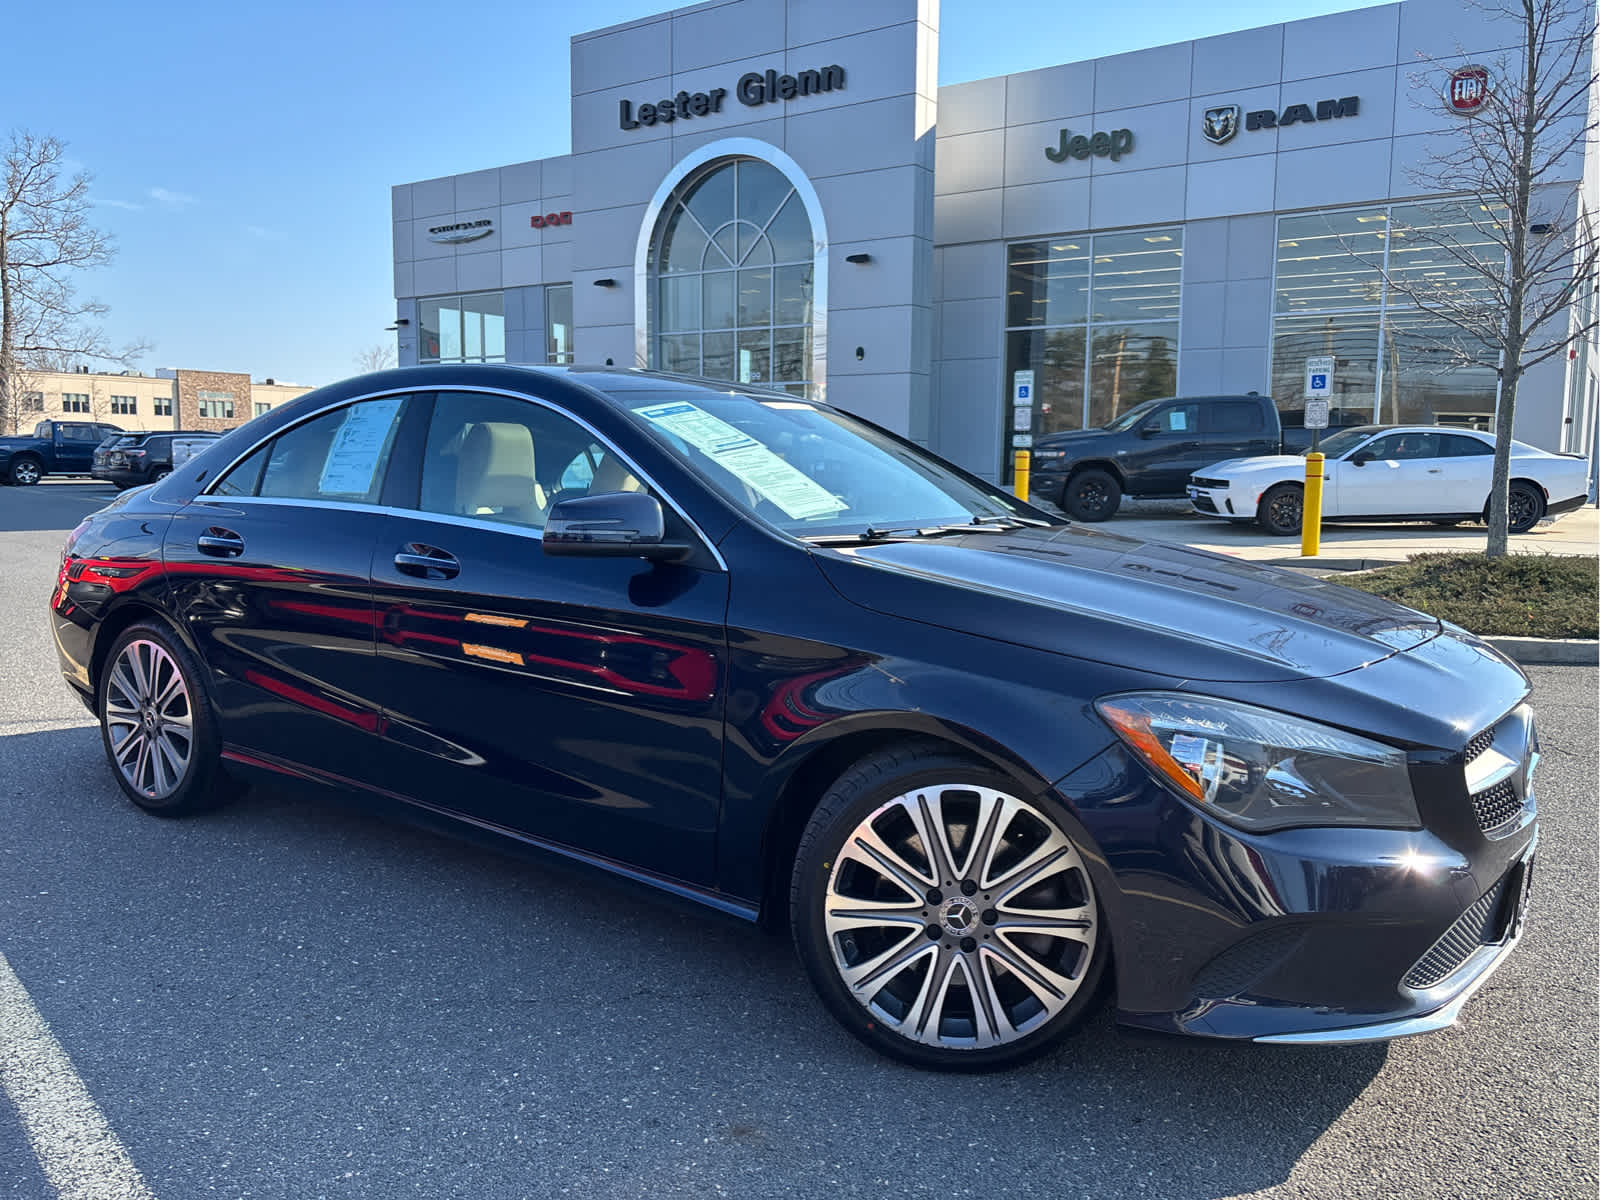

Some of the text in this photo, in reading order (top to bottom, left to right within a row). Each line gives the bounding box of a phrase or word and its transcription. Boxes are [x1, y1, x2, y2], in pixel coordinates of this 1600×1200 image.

[619, 64, 846, 131] Lester Glenn
[1453, 76, 1486, 100] FIAT
[1246, 95, 1361, 131] RAM
[1045, 128, 1134, 163] Jeep
